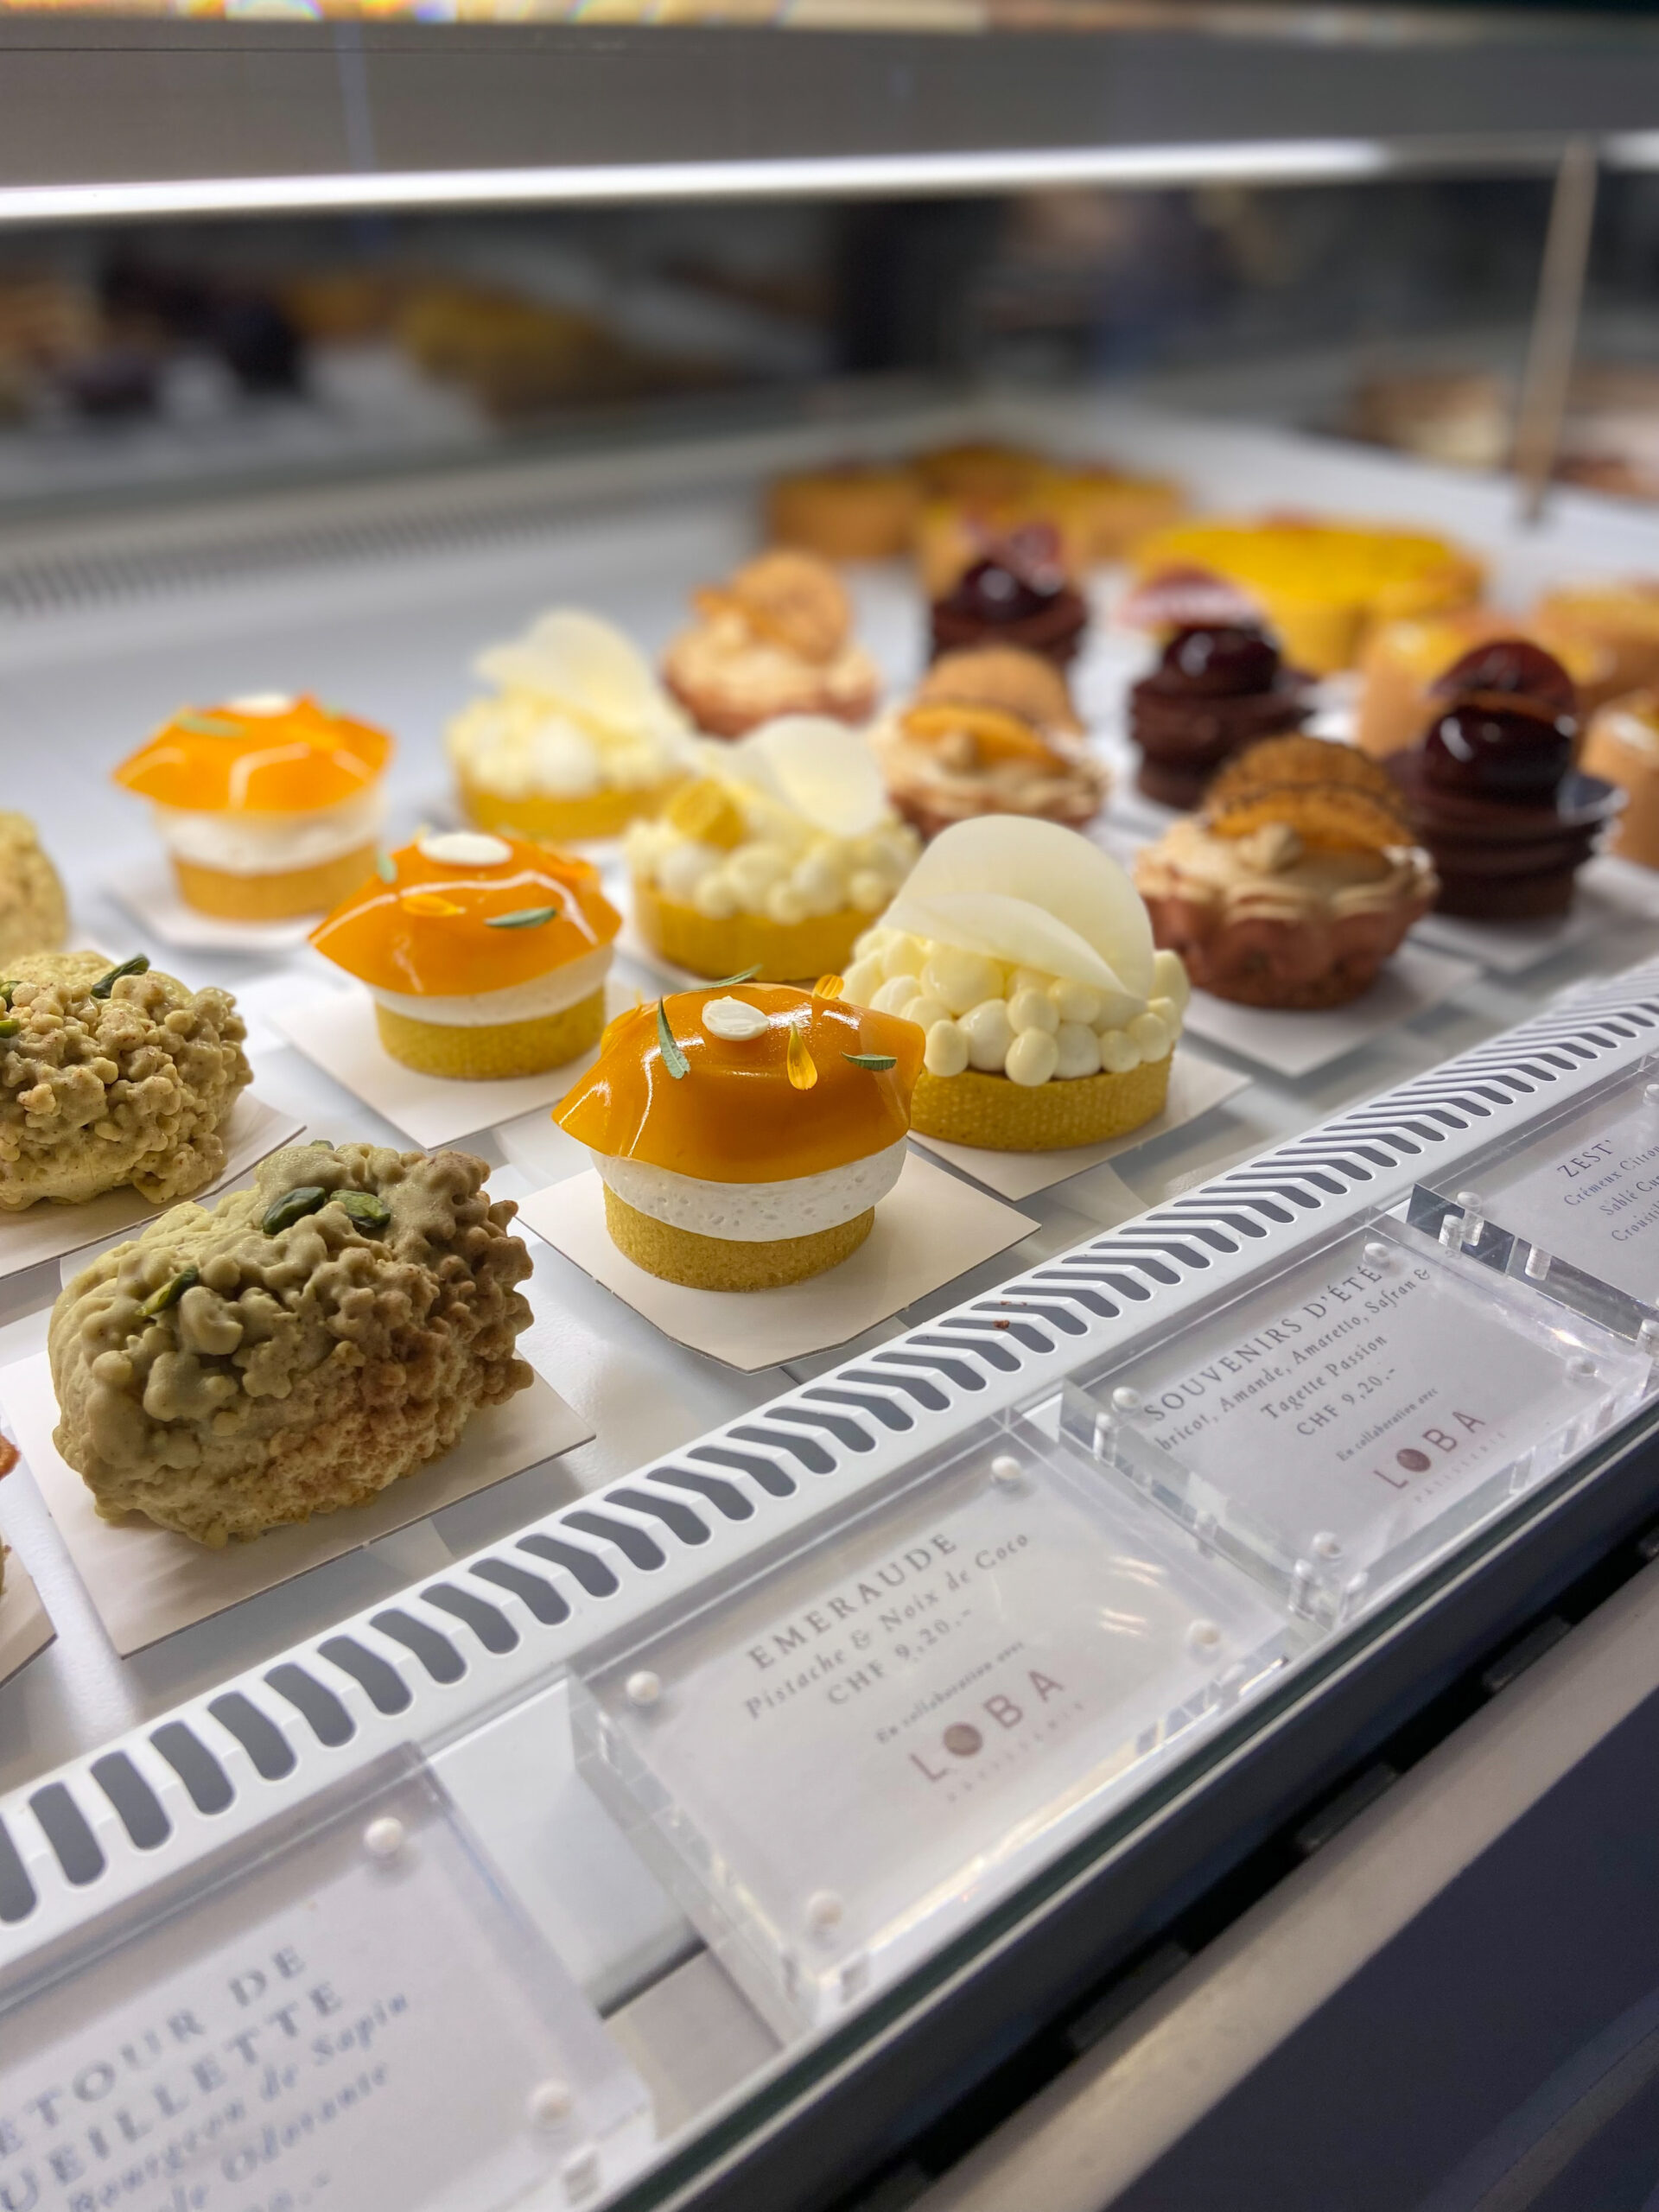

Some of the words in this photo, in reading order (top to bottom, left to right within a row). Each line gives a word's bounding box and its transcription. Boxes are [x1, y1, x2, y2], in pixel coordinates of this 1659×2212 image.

[1563, 1171, 1623, 1206] Crémeux
[1599, 1190, 1638, 1217] Sablé
[1143, 1318, 1303, 1421] SOUVENIRS
[1302, 1265, 1383, 1319] D'ÉTÉ
[1219, 1366, 1294, 1414] Amande,
[1291, 1315, 1370, 1365] Amaretto,
[1363, 1280, 1417, 1314] Safran
[1413, 1268, 1431, 1281] &
[1259, 1375, 1327, 1421] Tagette
[1324, 1335, 1388, 1377] Passion
[1295, 1403, 1339, 1436] CHF
[742, 1649, 847, 1719] Pistache
[849, 1629, 872, 1651] &
[878, 1589, 940, 1634] Noix
[945, 1567, 972, 1592] de
[974, 1533, 1029, 1571] Coco
[746, 1532, 958, 1670] EMERAUDE
[826, 1659, 885, 1707] CHF
[228, 1946, 306, 2007] DE
[311, 1992, 409, 2066] Sapin
